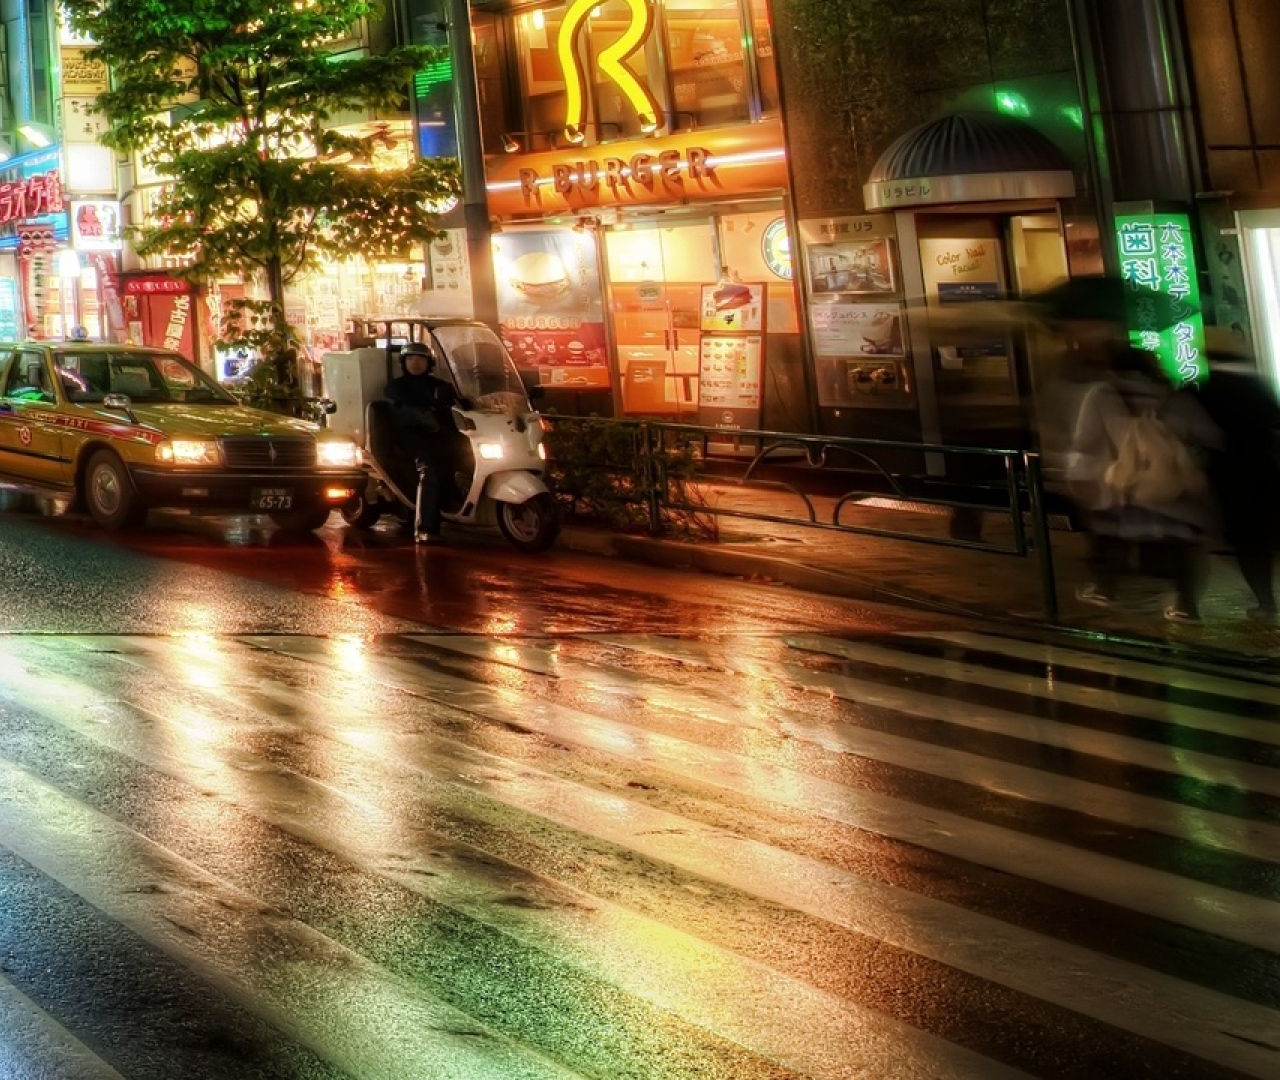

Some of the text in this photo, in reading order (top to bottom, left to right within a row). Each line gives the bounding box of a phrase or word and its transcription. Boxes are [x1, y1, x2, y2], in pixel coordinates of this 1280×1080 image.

[553, 146, 720, 196] BURGER
[883, 185, 930, 198] リラビル
[853, 221, 873, 232] リラ
[1119, 222, 1161, 292] 歯科
